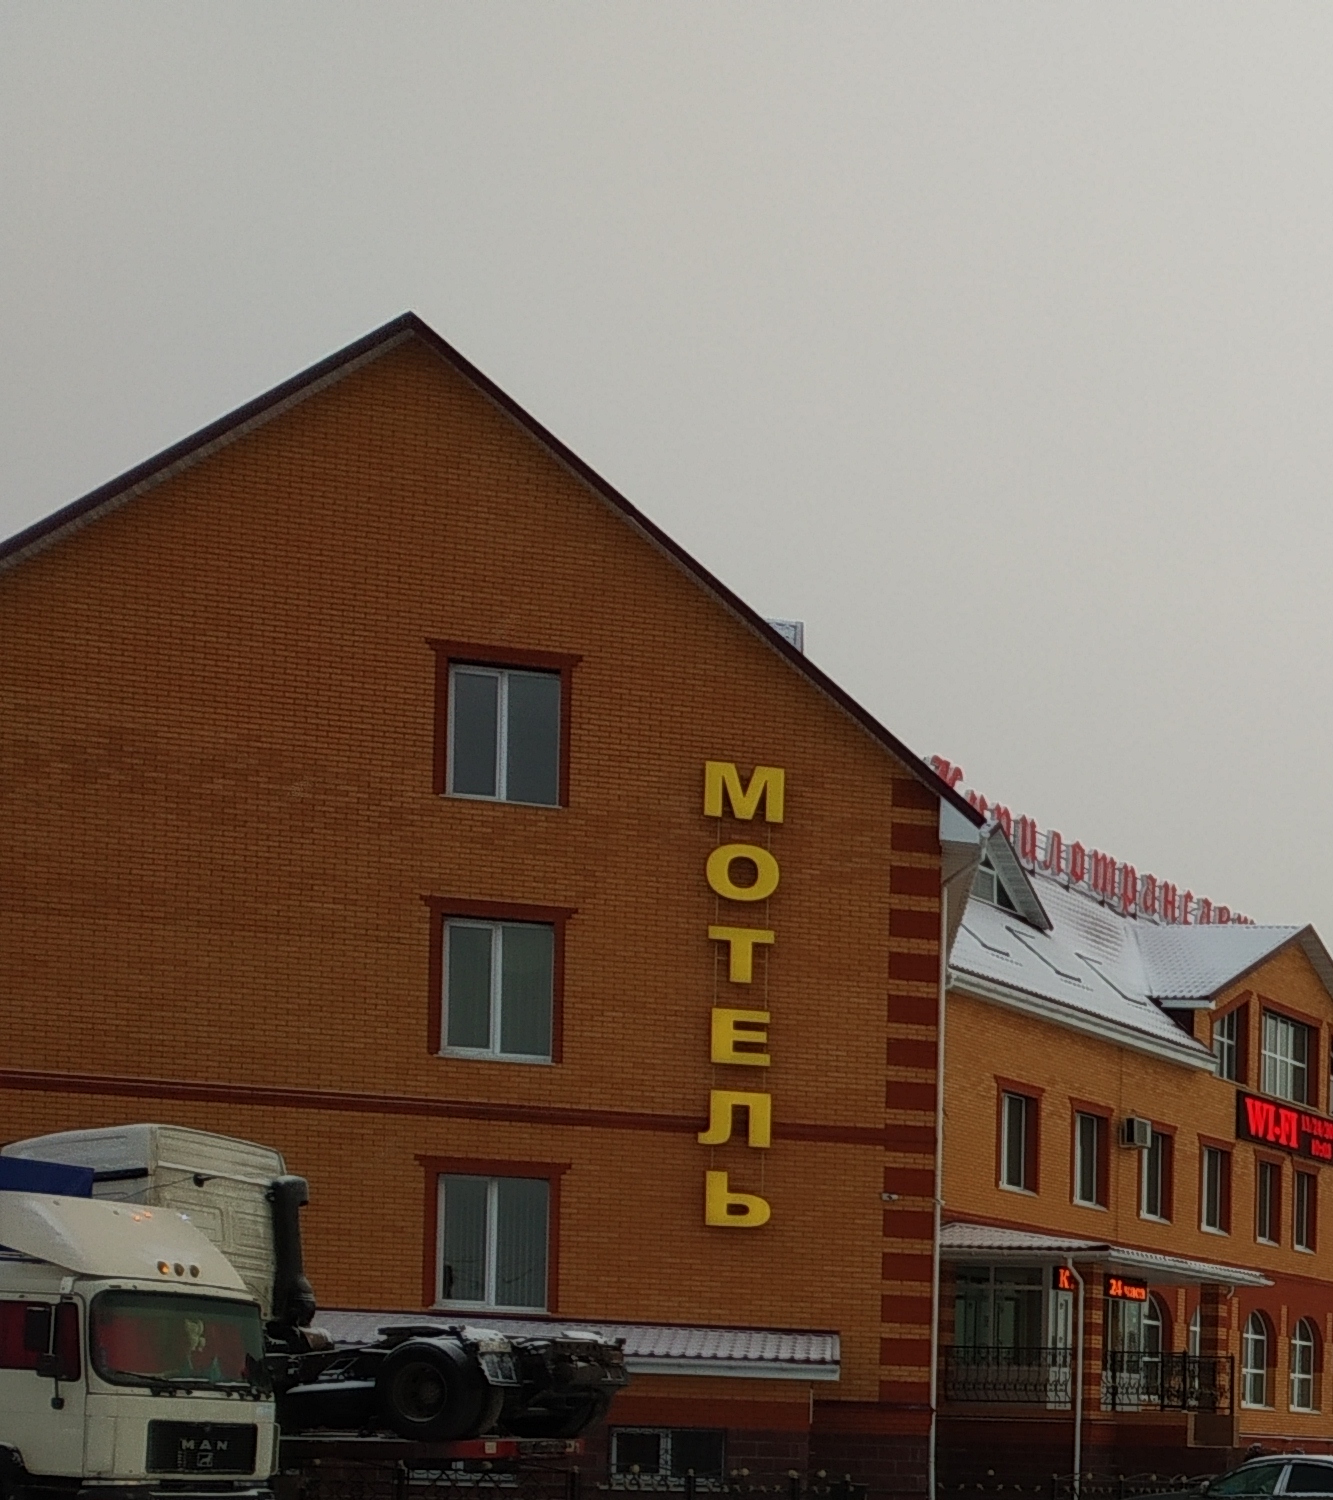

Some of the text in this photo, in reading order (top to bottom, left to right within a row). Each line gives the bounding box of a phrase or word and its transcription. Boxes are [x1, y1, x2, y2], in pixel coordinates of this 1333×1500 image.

[698, 760, 785, 1228] МОТЕЛЬ
[1109, 1278, 1146, 1300] 24 часа
[182, 1440, 228, 1450] MAN
